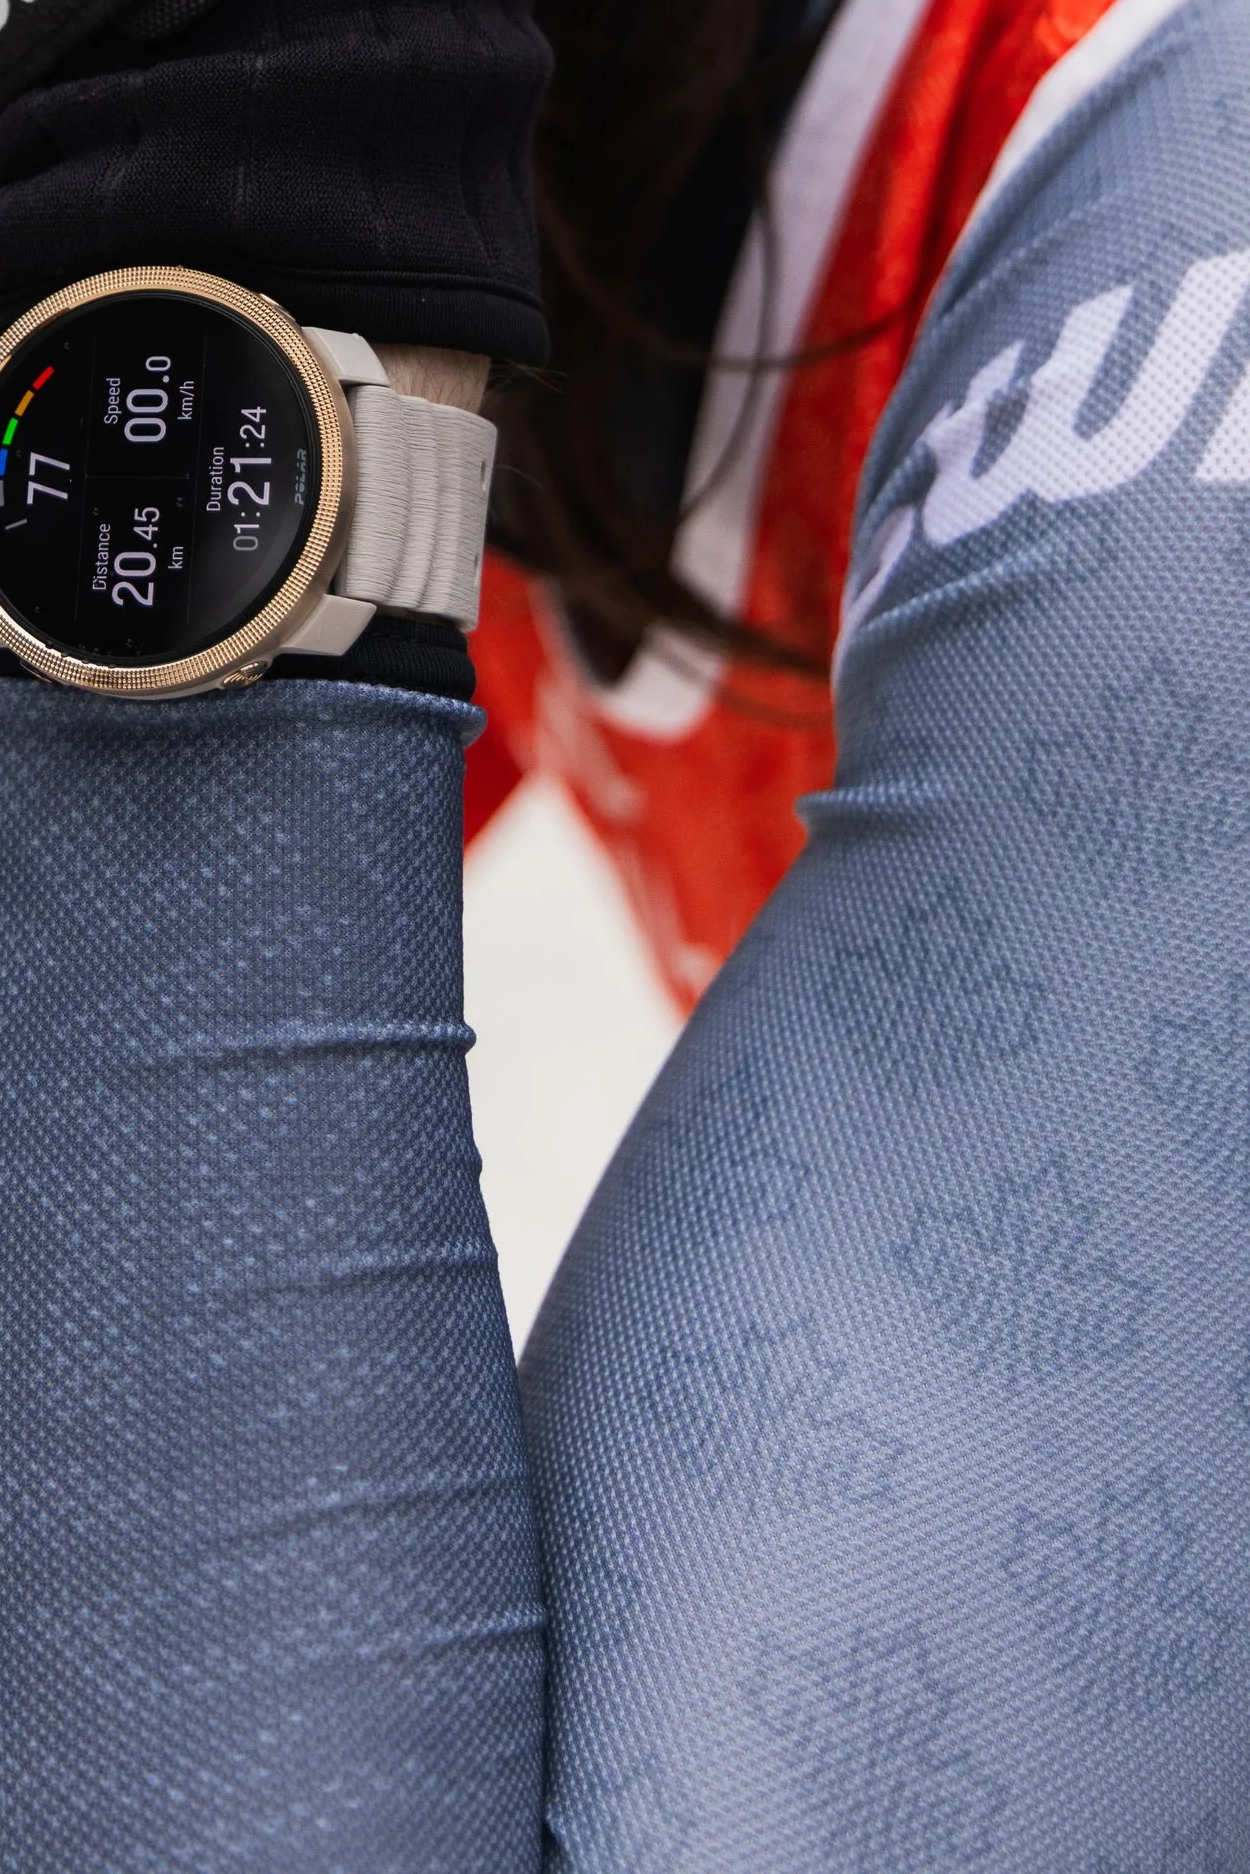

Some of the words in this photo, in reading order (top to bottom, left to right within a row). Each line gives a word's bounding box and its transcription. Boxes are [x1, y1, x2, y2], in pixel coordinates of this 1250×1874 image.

[103, 376, 121, 425] Speed
[123, 355, 172, 444] 00.0
[176, 379, 196, 421] km/h
[26, 451, 71, 506] 77
[205, 445, 225, 512] Duration
[227, 406, 272, 551] 01:21:24
[294, 448, 307, 505] POLAR
[91, 523, 112, 592] Distance
[111, 506, 161, 607] 20.45
[167, 545, 184, 570] km
